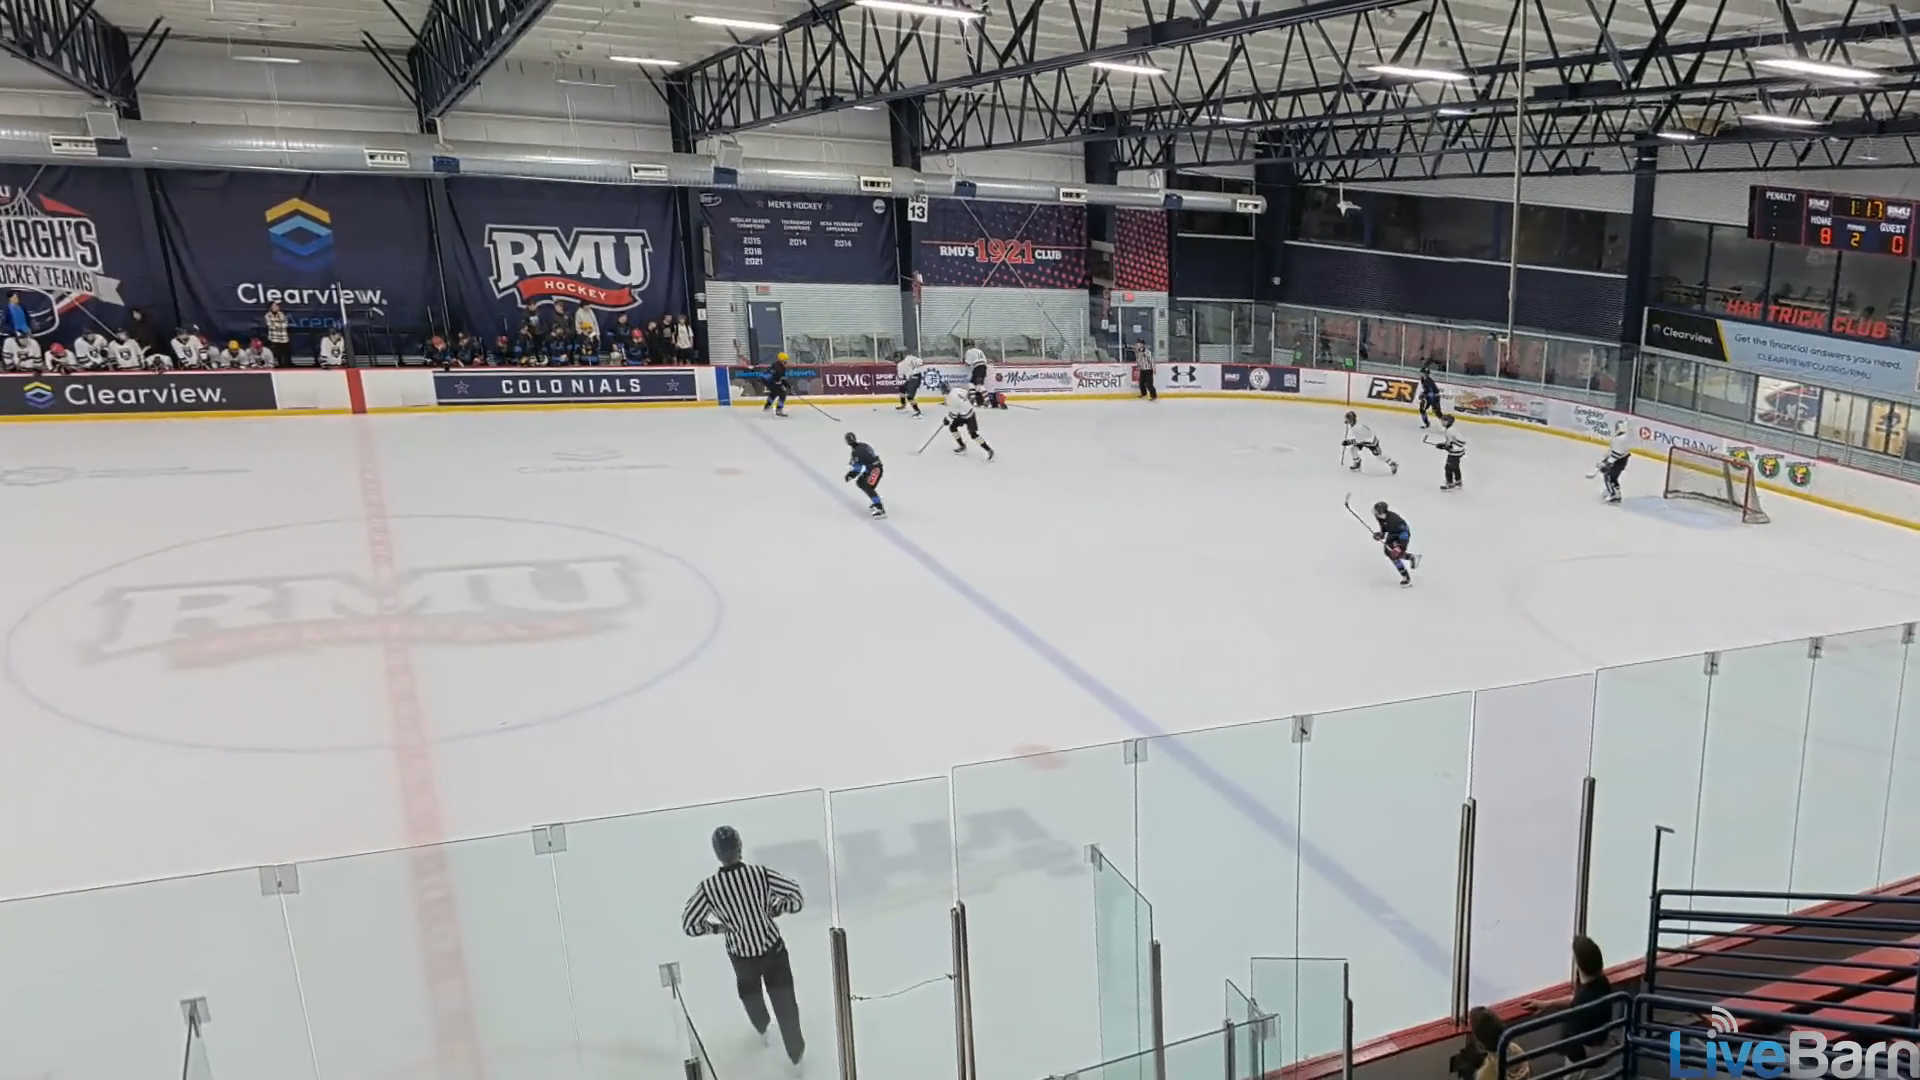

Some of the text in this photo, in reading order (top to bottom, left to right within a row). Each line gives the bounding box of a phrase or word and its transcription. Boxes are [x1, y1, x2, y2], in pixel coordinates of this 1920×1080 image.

[768, 200, 823, 211] MEN'S HOCKEY
[1766, 191, 1797, 202] PENALTY
[910, 205, 926, 219] 13
[1811, 215, 1833, 226] HOME
[1879, 223, 1907, 234] GUEST
[0, 219, 99, 267] URGH'S
[743, 236, 761, 245] 2015
[789, 237, 807, 247] 2014
[834, 239, 852, 248] 2014
[1820, 227, 1832, 245] 8
[1850, 232, 1861, 247] 2
[488, 231, 647, 289] RMU
[940, 238, 1062, 264] RMU'S 1921 CLUB
[745, 257, 763, 265] 2021
[43, 266, 93, 292] TEAMS
[236, 282, 388, 306] Clearview.
[544, 280, 607, 300] HOCKEY
[1724, 300, 1890, 339] HAT TRICK CLUB
[1663, 326, 1715, 345] Clearview.
[1734, 333, 1902, 370] Get the financial answers you need.
[825, 373, 872, 388] UPMC
[1005, 371, 1039, 386] Molson
[1077, 374, 1125, 388] AIRPORT
[1079, 371, 1111, 379] BREWER
[64, 383, 227, 406] Clearview.
[502, 378, 641, 395] COLONIALS
